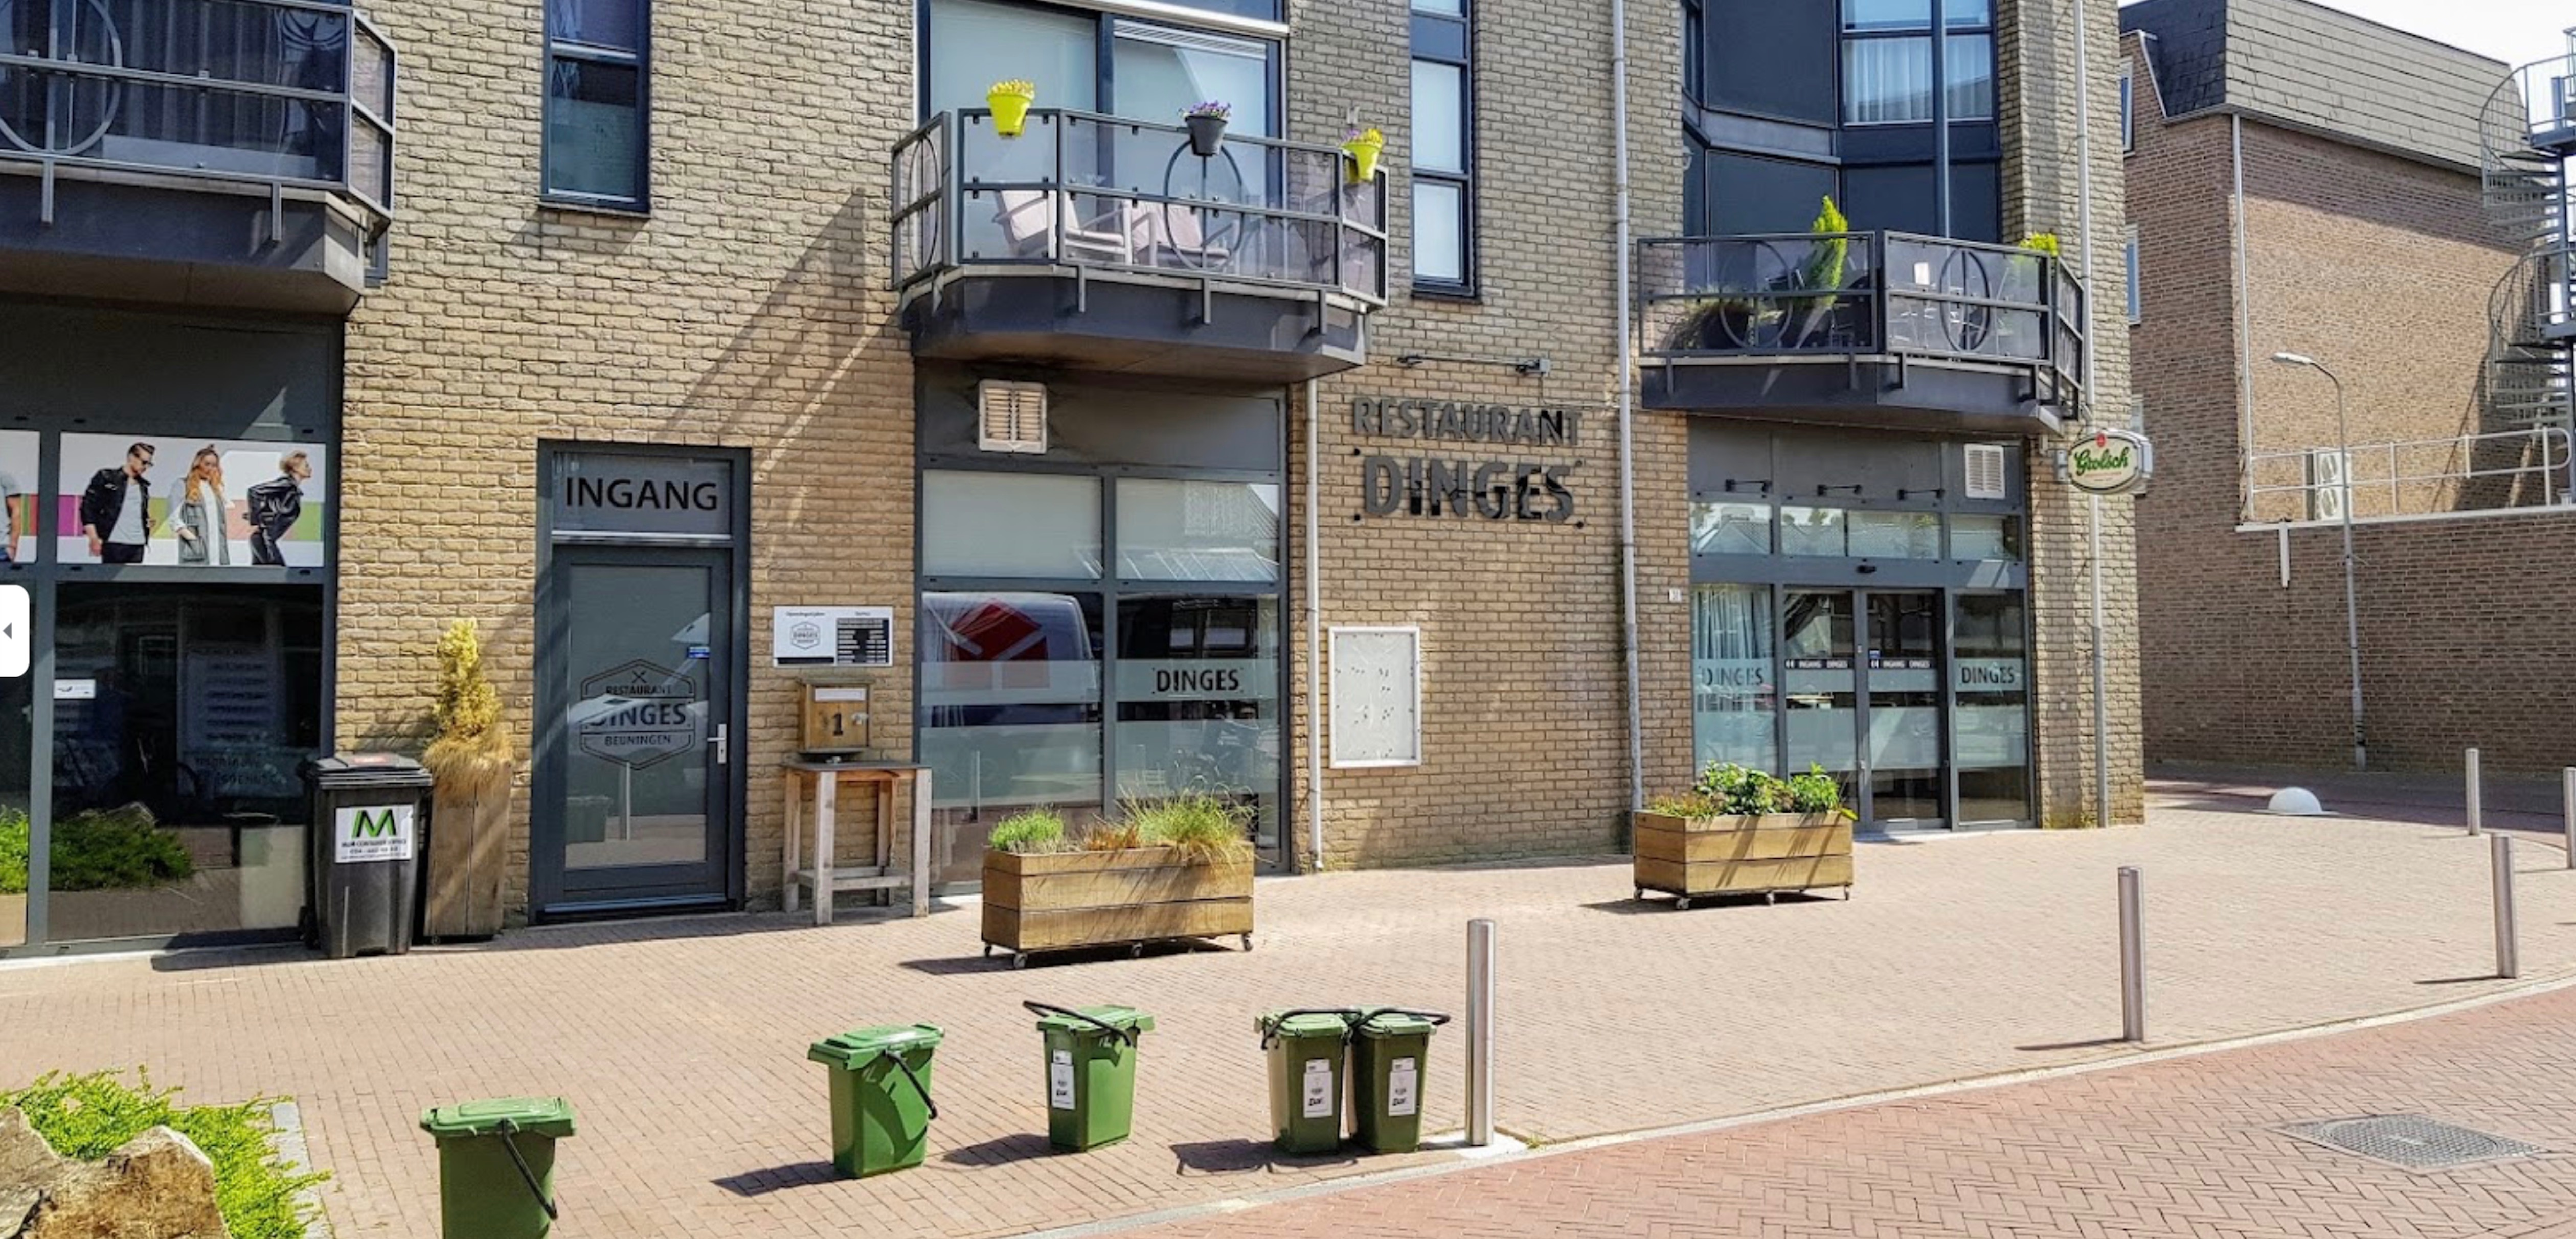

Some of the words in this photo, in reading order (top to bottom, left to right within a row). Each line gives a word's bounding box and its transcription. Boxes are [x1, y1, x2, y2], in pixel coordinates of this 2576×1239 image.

[1353, 395, 1583, 446] RESTAURANT
[2074, 446, 2130, 476] Grolsch
[566, 477, 718, 511] INGANG
[1365, 455, 1574, 522] DINGES
[1157, 669, 1238, 692] DINGES
[1701, 667, 1763, 686] DINGES
[1962, 666, 2014, 684] DINGES
[606, 685, 671, 695] RESTAURANT
[832, 712, 844, 736] 1
[604, 735, 671, 746] BEUNINGEN
[351, 809, 397, 839] M
